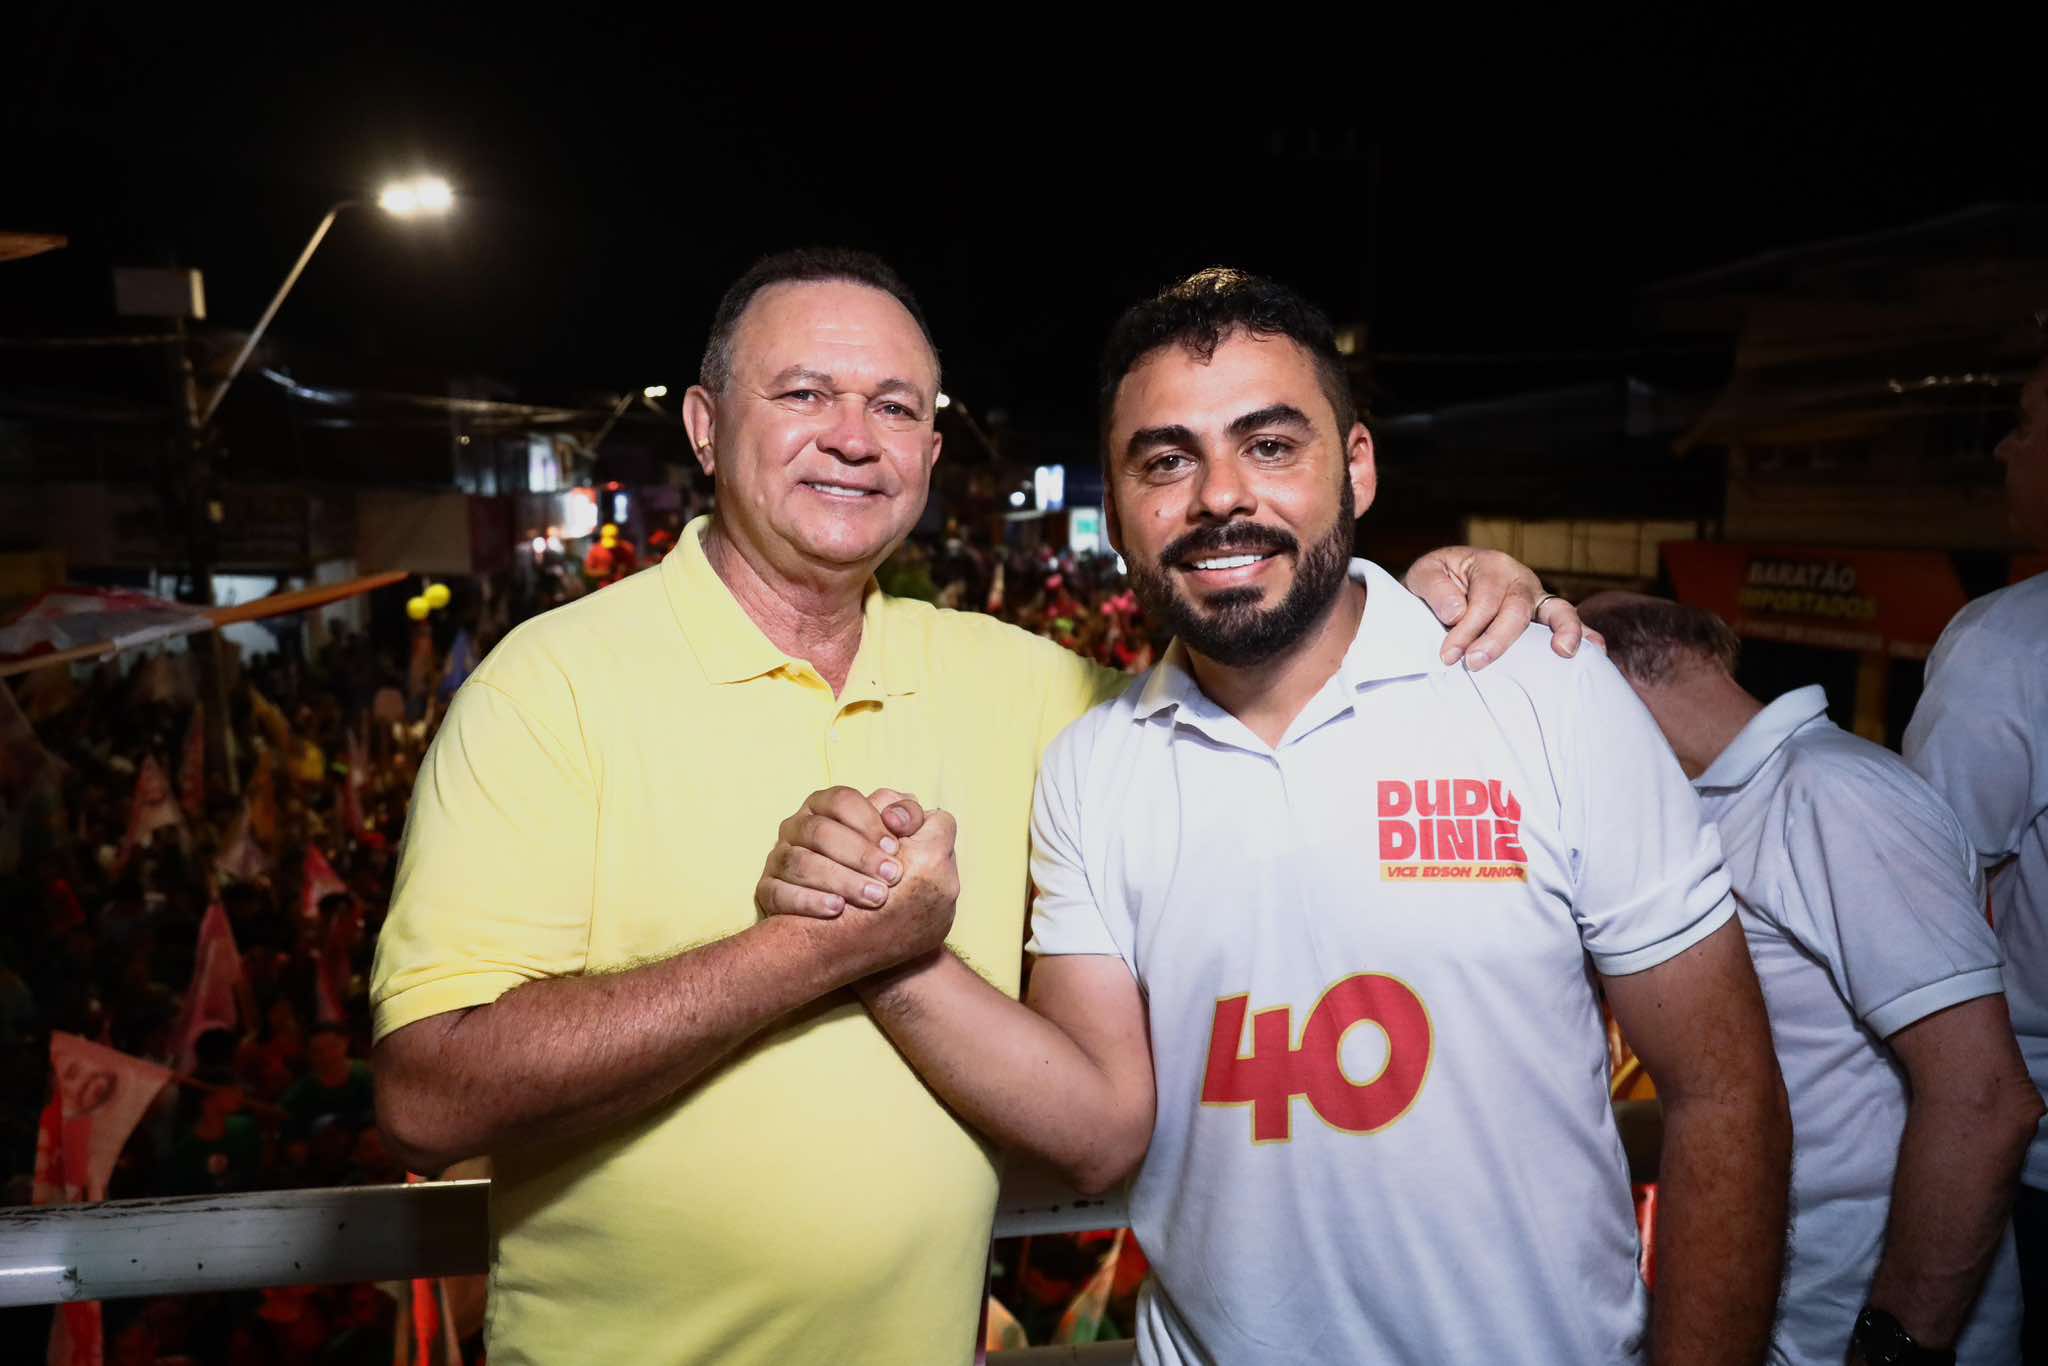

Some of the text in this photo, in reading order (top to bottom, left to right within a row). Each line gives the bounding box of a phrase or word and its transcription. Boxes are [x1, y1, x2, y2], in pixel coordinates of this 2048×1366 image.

[1376, 779, 1521, 822] DUDU
[1378, 818, 1528, 863] DINIZ
[1388, 866, 1524, 879] VICE EDSON JUNIOR
[1200, 970, 1435, 1146] 40
